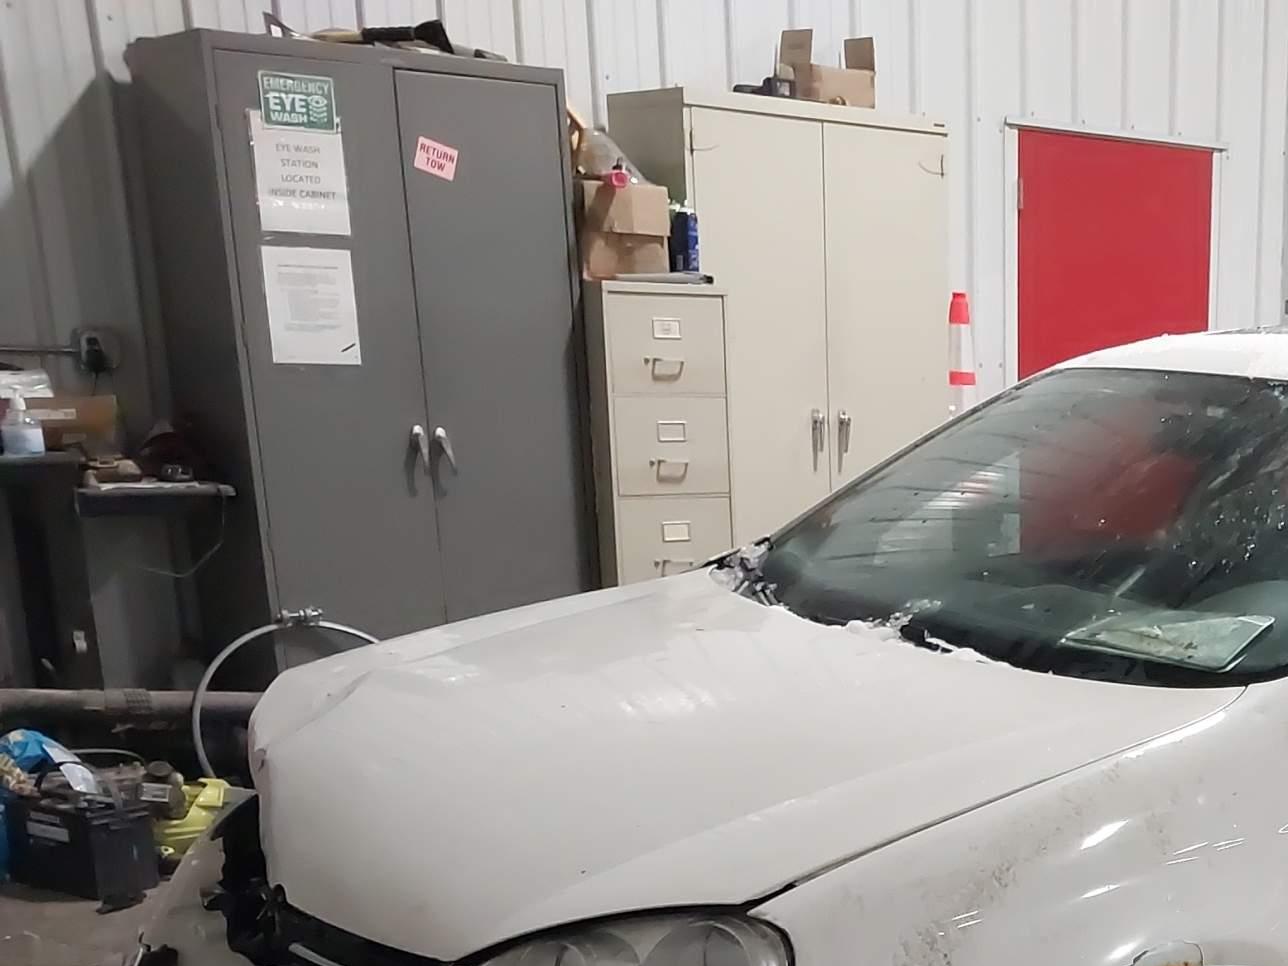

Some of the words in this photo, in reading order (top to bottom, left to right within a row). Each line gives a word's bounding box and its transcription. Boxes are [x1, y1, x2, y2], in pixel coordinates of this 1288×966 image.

[263, 76, 329, 95] EMERGENCY
[269, 91, 307, 112] EYE
[271, 111, 308, 123] WASH
[275, 143, 291, 153] EYE
[293, 144, 320, 154] WASH
[419, 142, 455, 164] RETURN
[280, 158, 319, 168] STATION
[425, 157, 446, 171] TOW
[280, 174, 321, 184] LOCATED
[269, 188, 297, 198] INSIDE
[299, 189, 336, 200] CABINET
